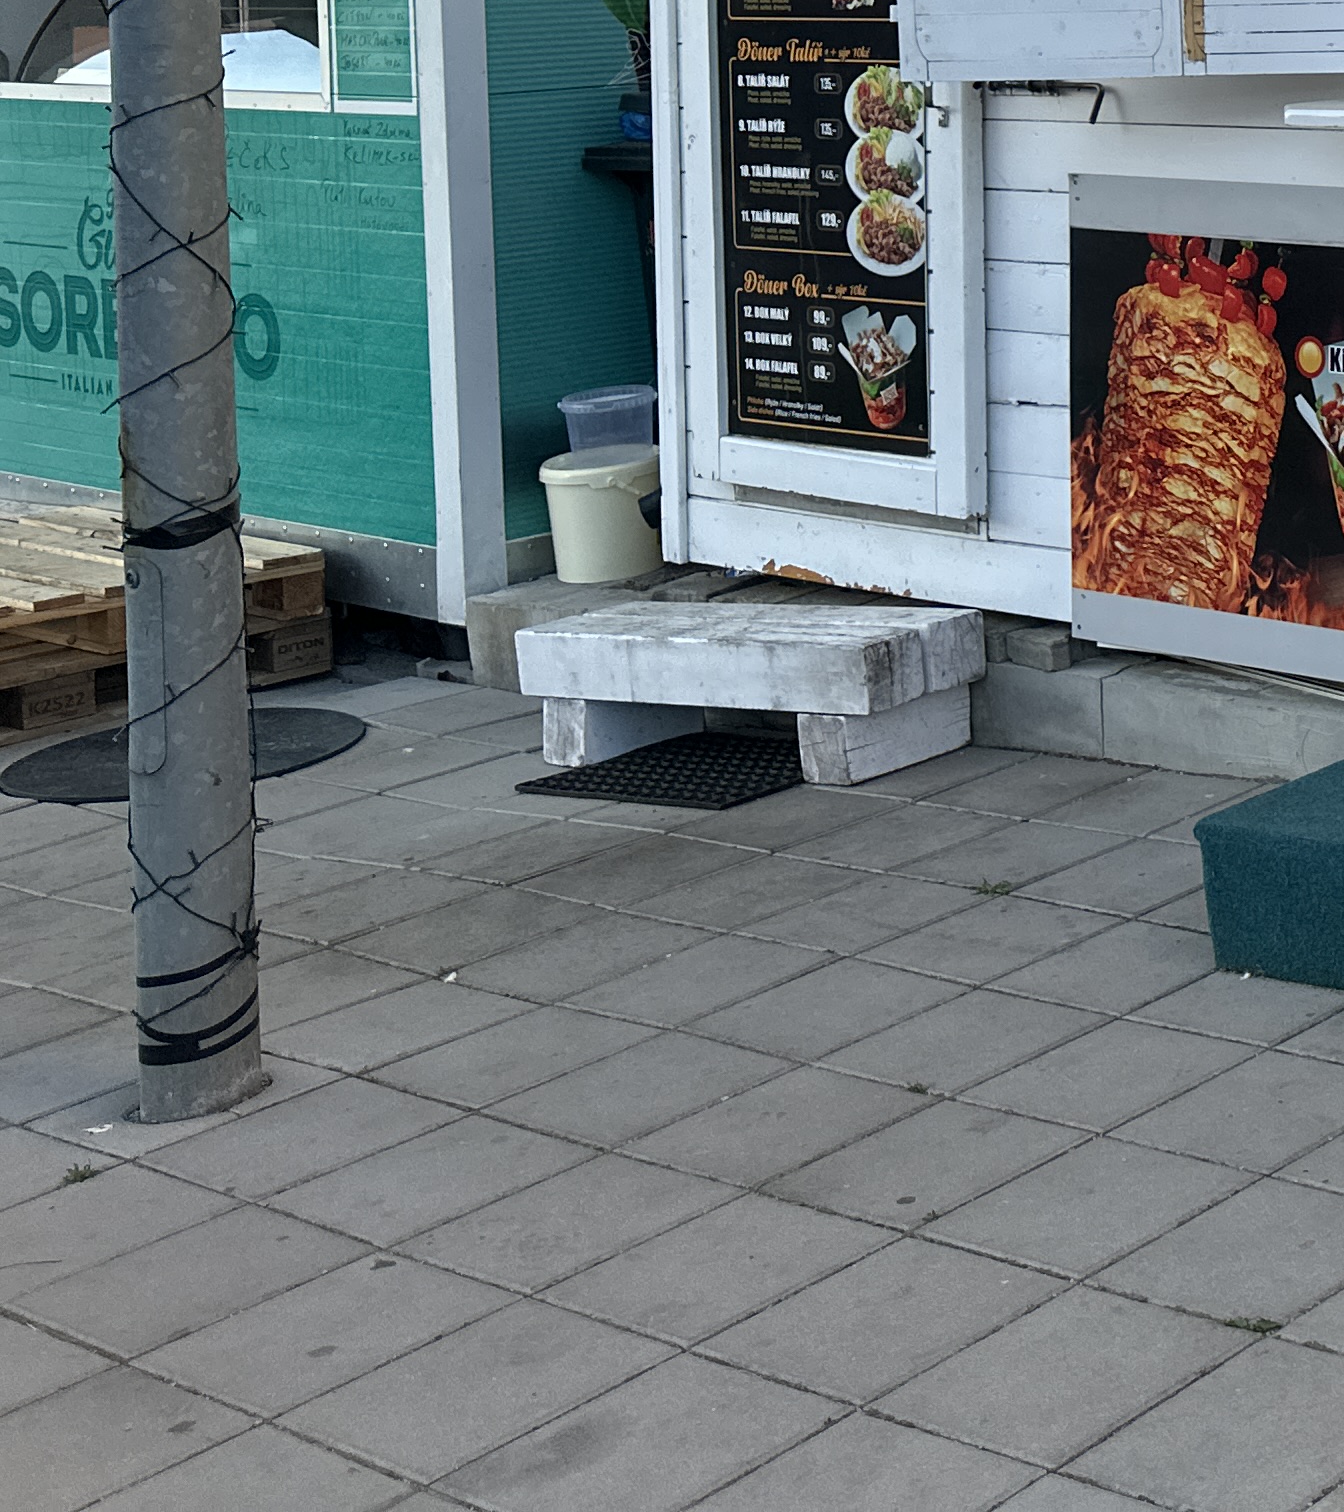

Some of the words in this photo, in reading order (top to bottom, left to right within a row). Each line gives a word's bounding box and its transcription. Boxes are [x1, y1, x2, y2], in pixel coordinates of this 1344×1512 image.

[737, 38, 782, 61] Döner
[743, 270, 788, 295] Döner
[792, 274, 819, 298] Box
